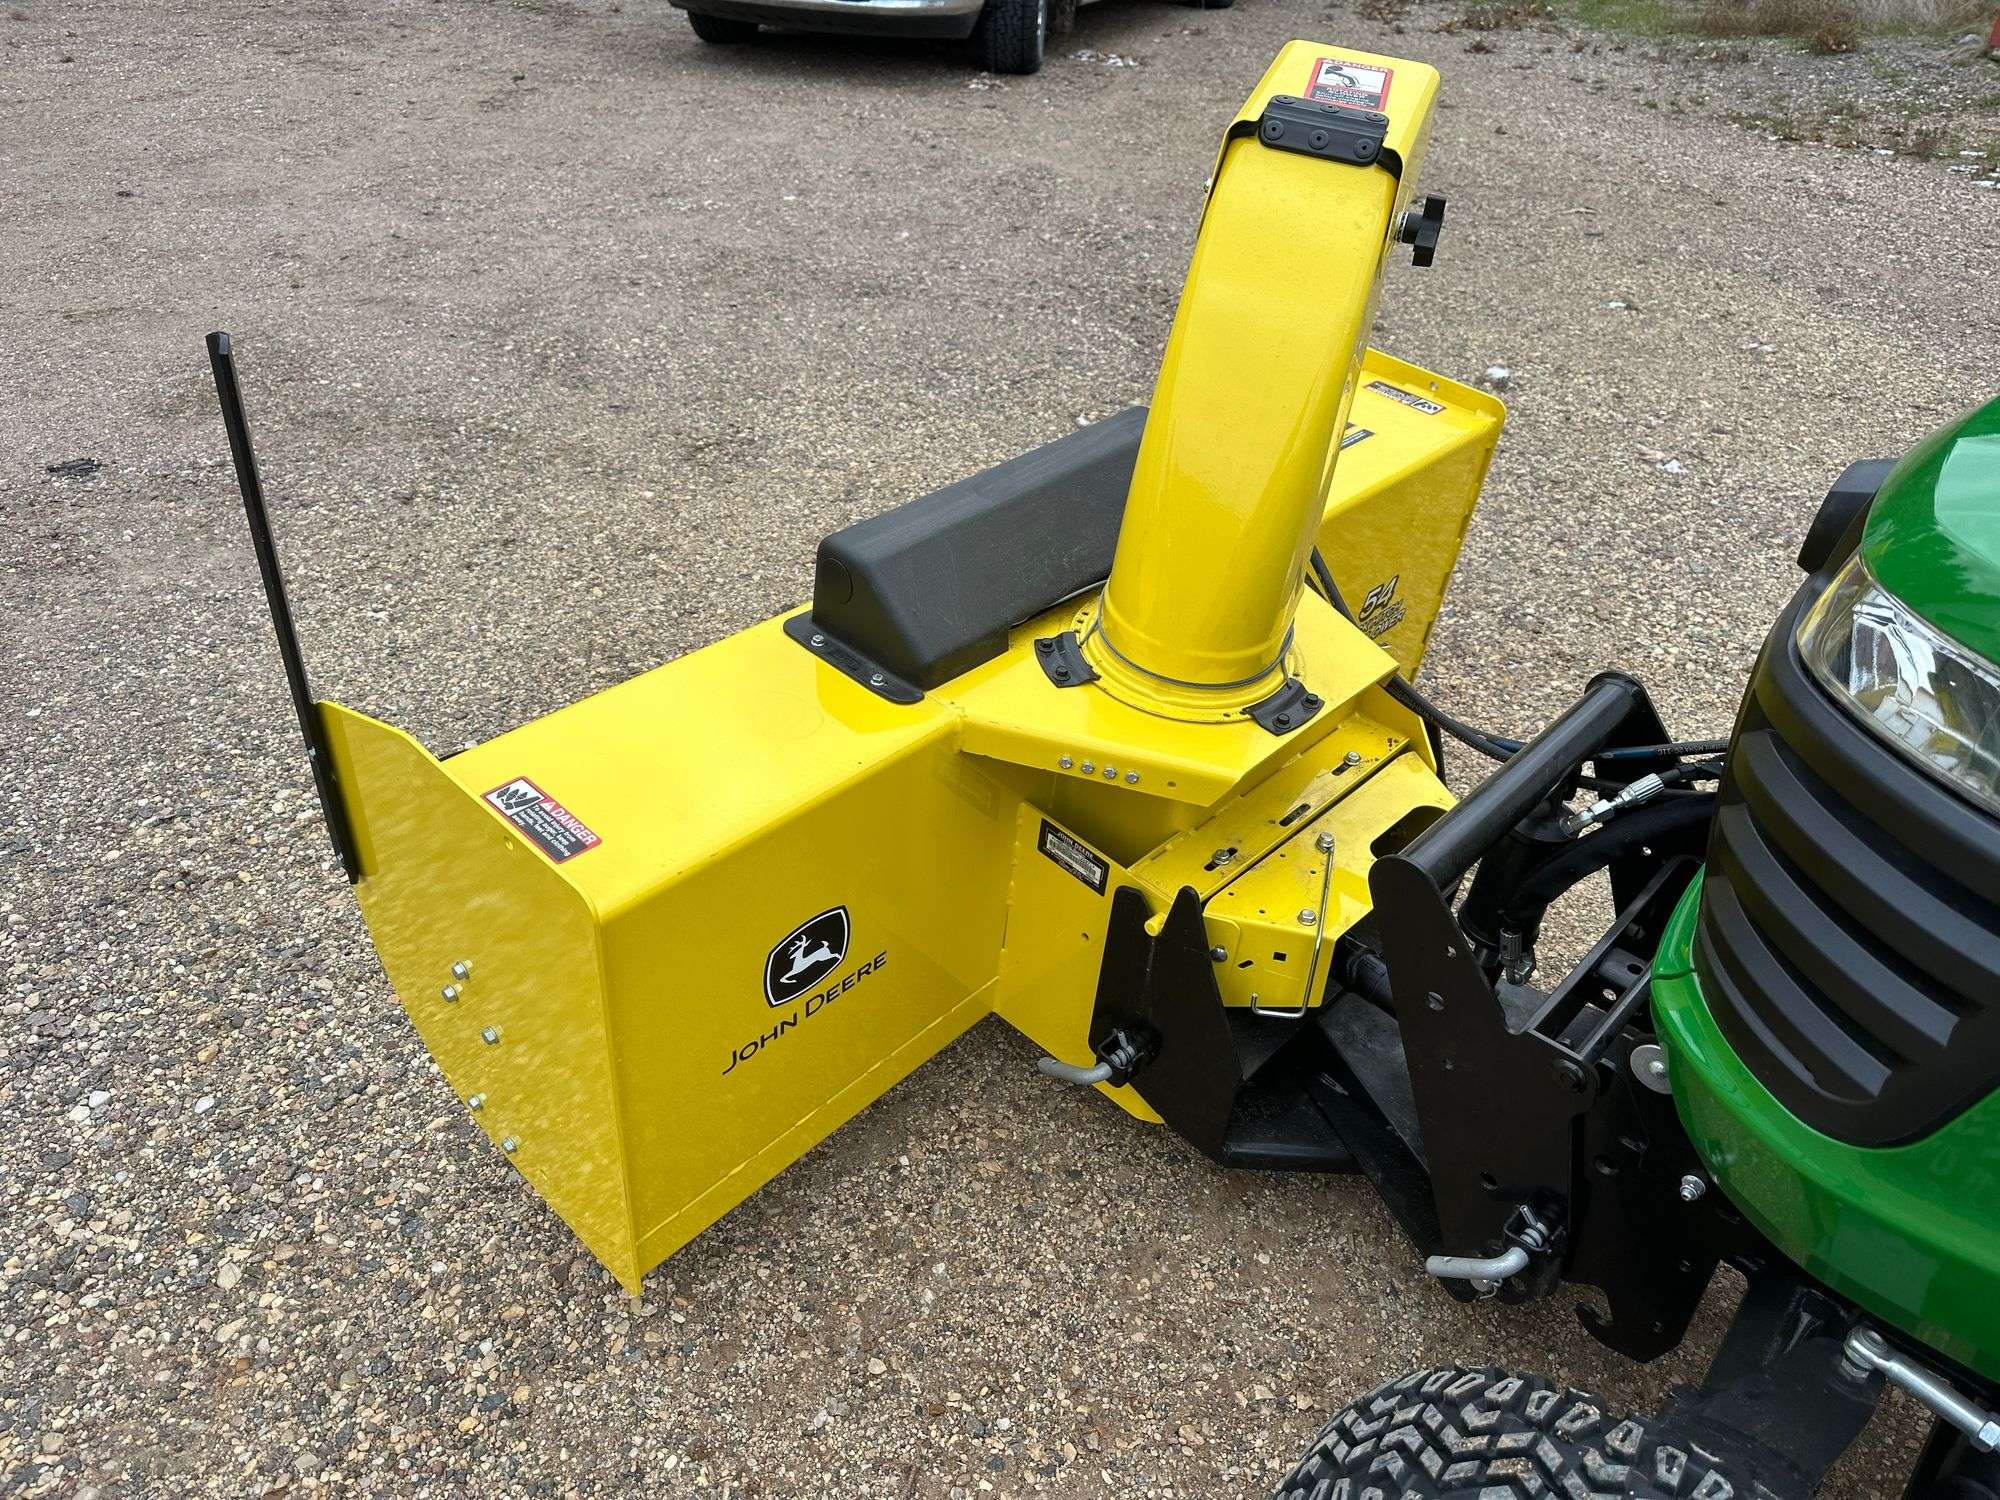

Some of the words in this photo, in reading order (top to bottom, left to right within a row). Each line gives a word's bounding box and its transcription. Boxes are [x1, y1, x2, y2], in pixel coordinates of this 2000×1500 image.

[1334, 60, 1387, 72] DANGER
[1358, 575, 1399, 622] 54
[523, 807, 545, 824] rotating
[554, 834, 570, 845] keep
[532, 823, 545, 832] feet
[541, 831, 554, 840] and
[548, 838, 572, 857] clothing
[537, 809, 554, 822] avoid
[548, 820, 566, 833] injury
[562, 831, 577, 842] from
[549, 807, 598, 844] DANGER
[1058, 832, 1073, 844] JOHN
[1075, 843, 1094, 858] DEERE
[722, 1012, 798, 1075] JOHN
[805, 951, 887, 1018] DEERE
